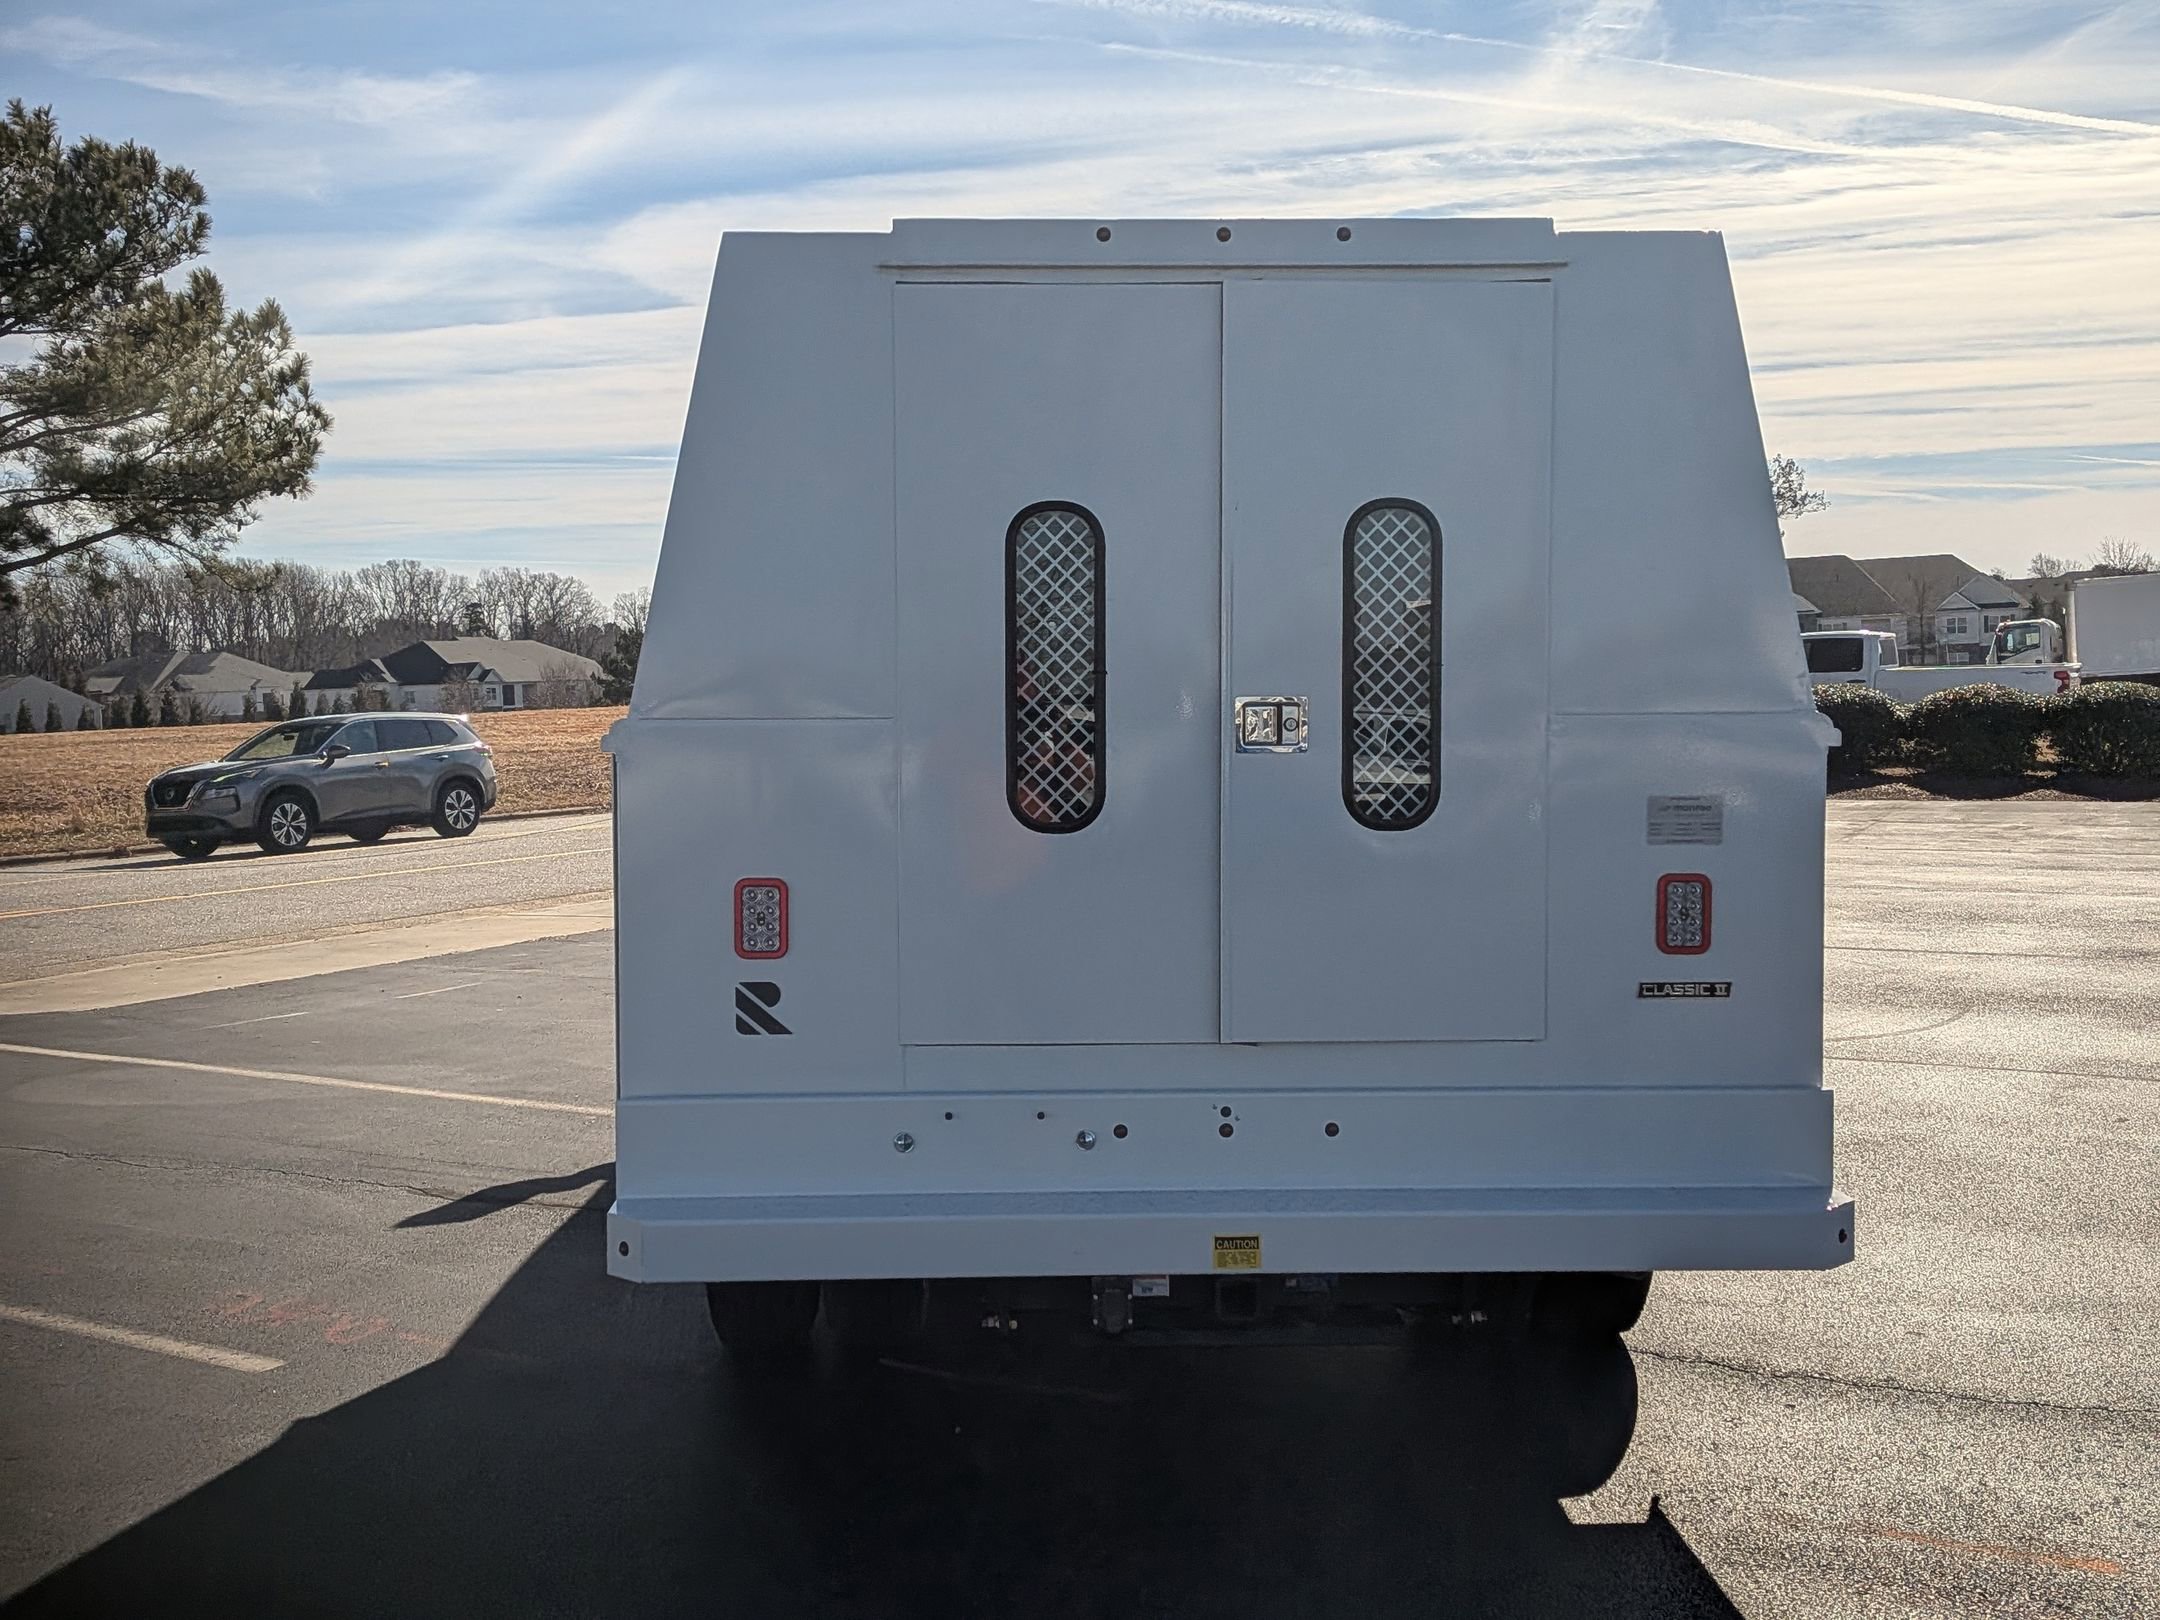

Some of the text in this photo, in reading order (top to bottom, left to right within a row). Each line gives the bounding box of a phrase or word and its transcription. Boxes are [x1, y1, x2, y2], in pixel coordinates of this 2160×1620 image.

[1641, 983, 1729, 996] CLASSIC II
[1216, 1239, 1258, 1249] CAUTION
